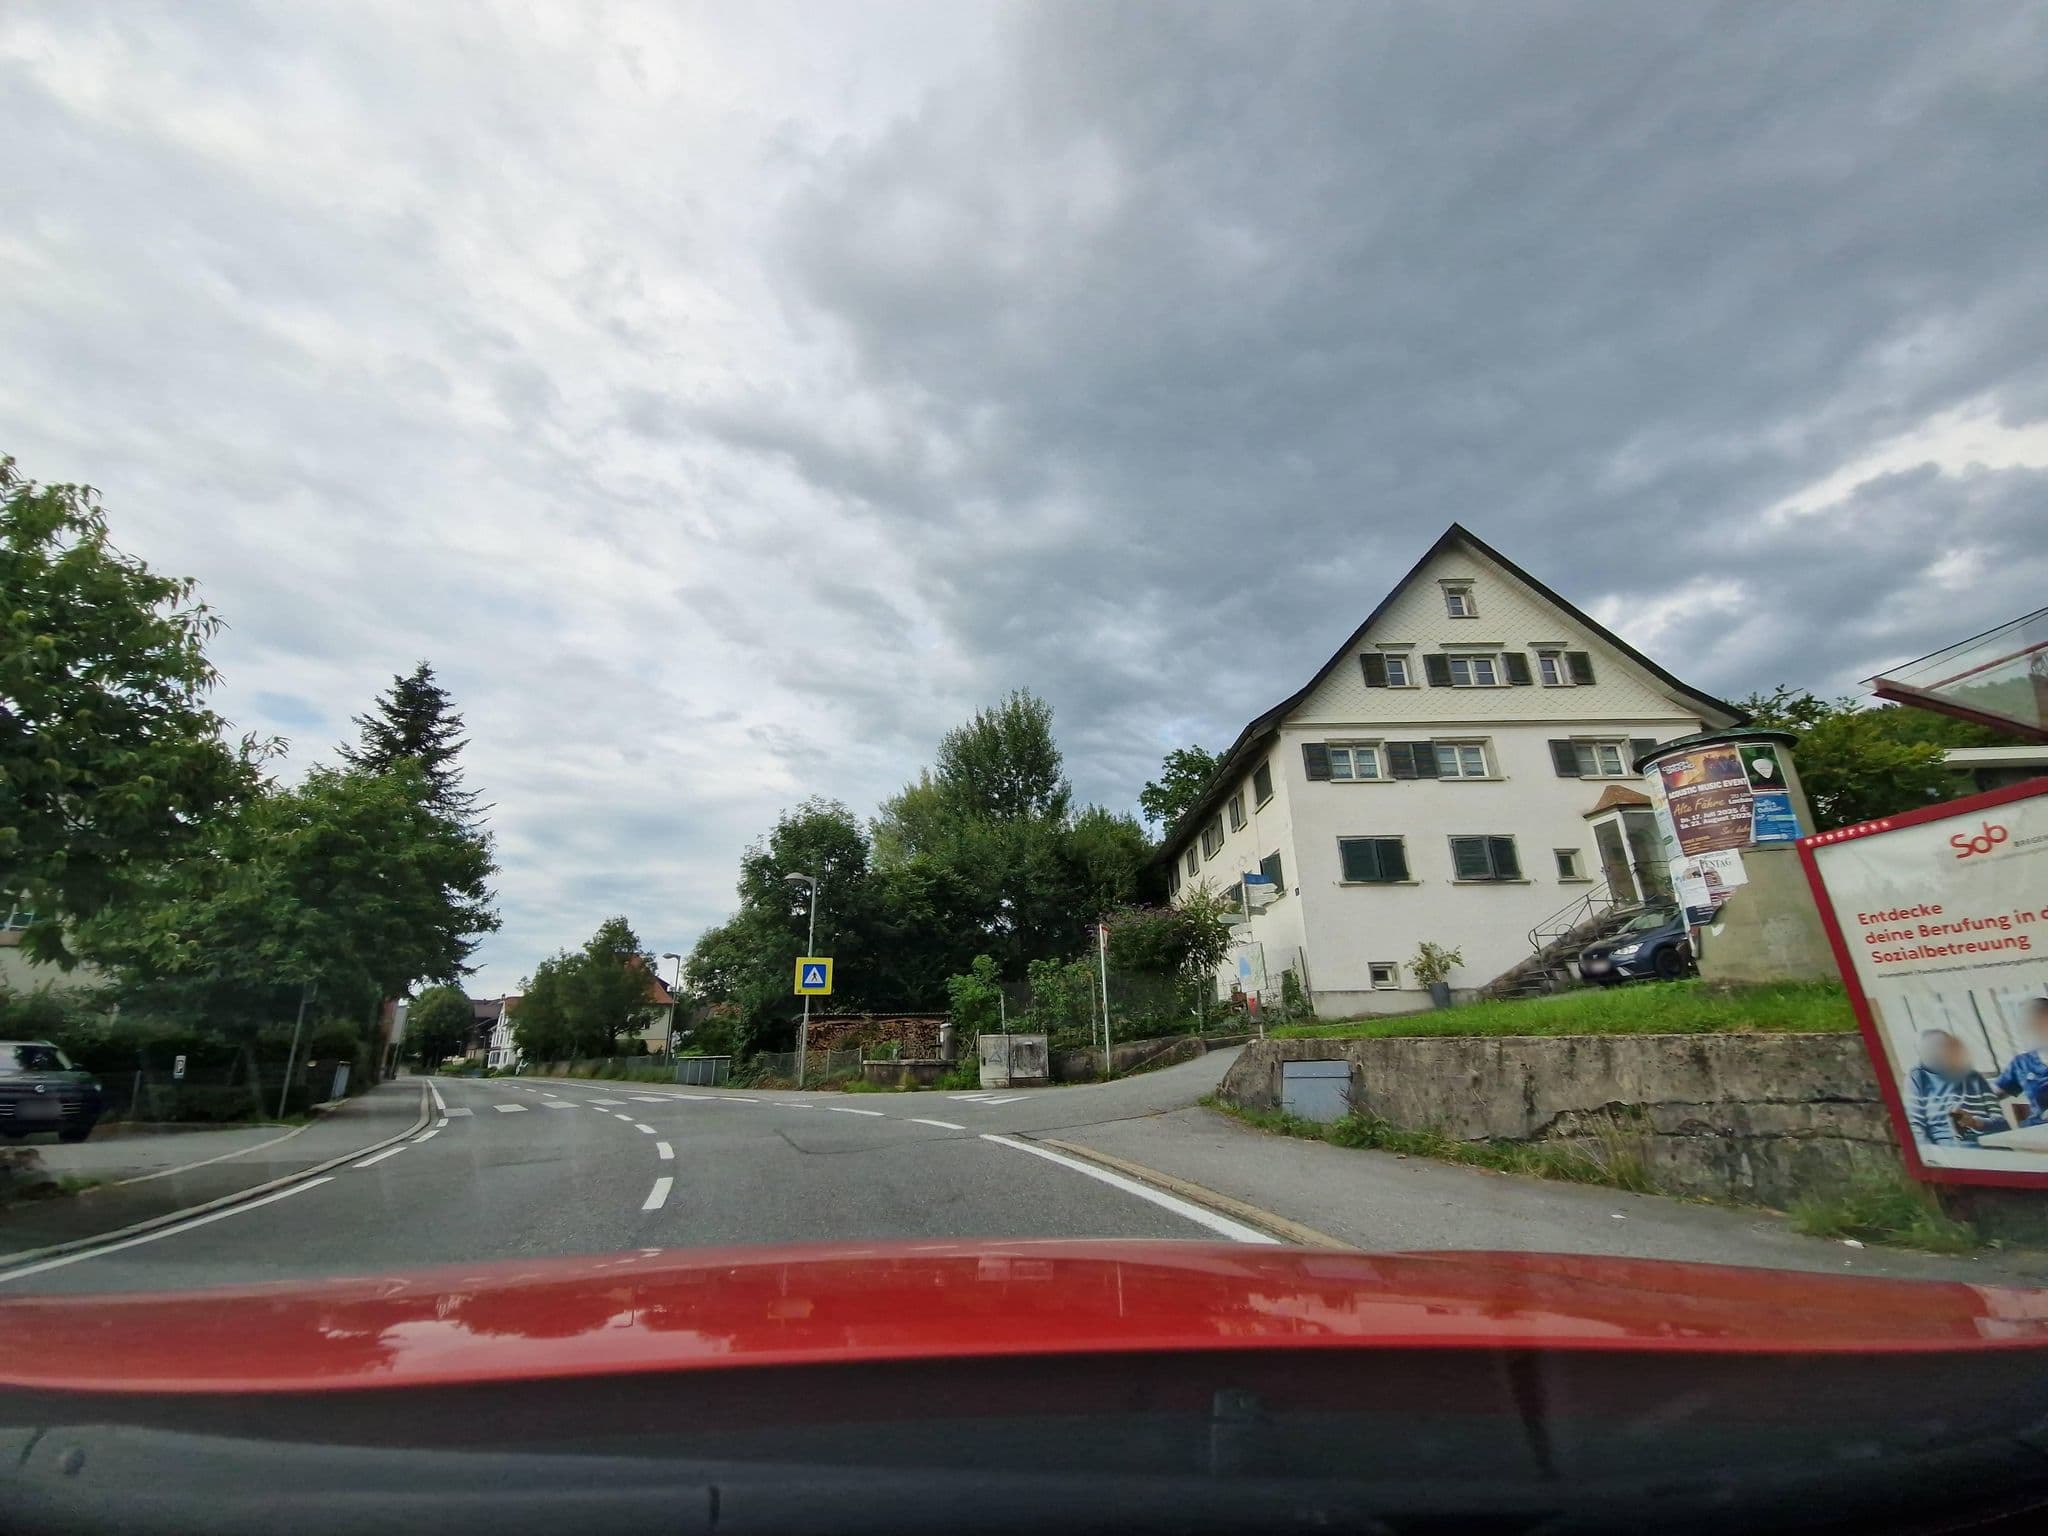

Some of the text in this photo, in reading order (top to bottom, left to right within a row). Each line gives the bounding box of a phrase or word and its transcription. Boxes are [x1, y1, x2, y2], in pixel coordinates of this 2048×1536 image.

[1698, 781, 1722, 792] MUSIC
[1723, 777, 1747, 788] EVENT
[1717, 807, 1738, 816] 2025
[1731, 812, 1752, 820] 2025
[1857, 902, 1943, 926] Entdecke
[1865, 928, 1914, 945] deine
[1917, 914, 2012, 938] Berufung
[2015, 909, 2036, 925] in
[1871, 934, 2032, 964] Sozialbetreuung
